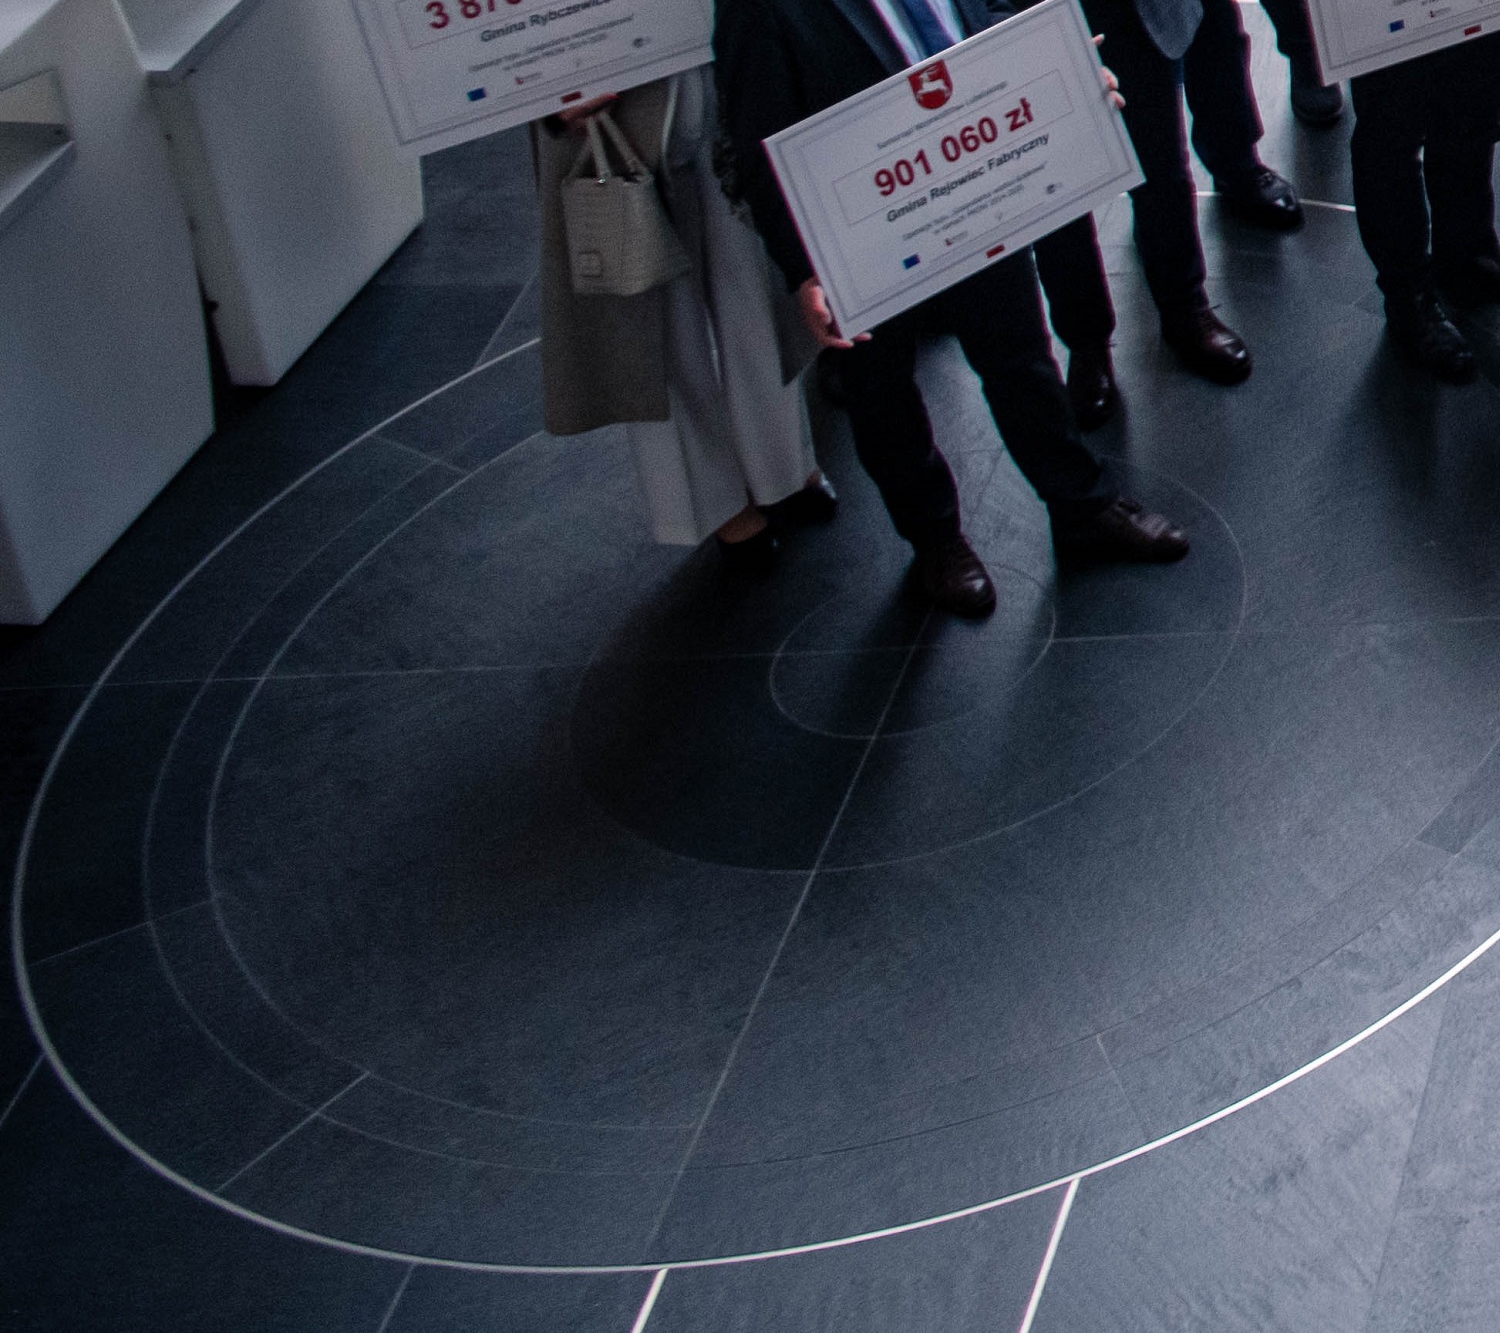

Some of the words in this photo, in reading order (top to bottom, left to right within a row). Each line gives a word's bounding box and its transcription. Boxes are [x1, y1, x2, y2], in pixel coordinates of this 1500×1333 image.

[874, 149, 931, 196] 901
[940, 117, 997, 162] 060
[1005, 97, 1033, 131] zł
[885, 195, 928, 223] Gmina
